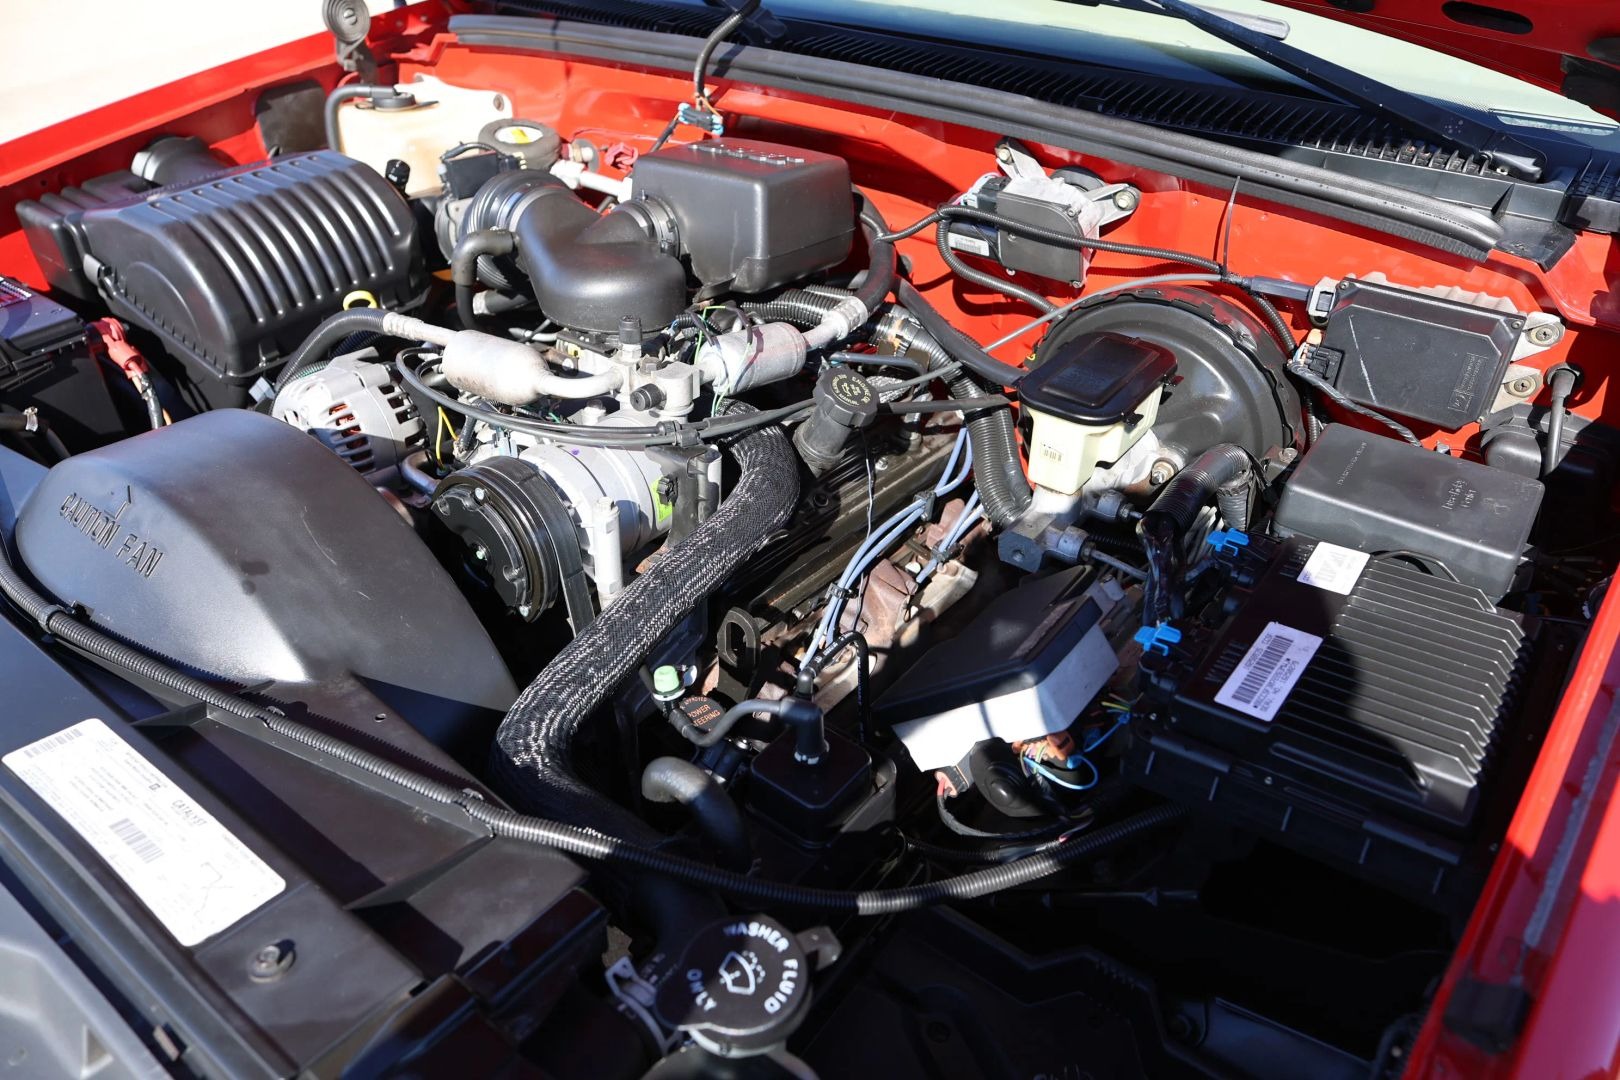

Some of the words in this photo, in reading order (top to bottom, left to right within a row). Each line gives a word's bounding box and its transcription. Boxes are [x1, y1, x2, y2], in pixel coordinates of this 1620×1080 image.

[60, 493, 120, 549] CAUTION
[116, 533, 163, 578] FAN
[693, 709, 721, 727] TEERING
[171, 799, 207, 827] CATALYST
[723, 921, 790, 953] WASHER
[686, 967, 717, 1012] ONLY
[763, 958, 799, 1013] FLUID
